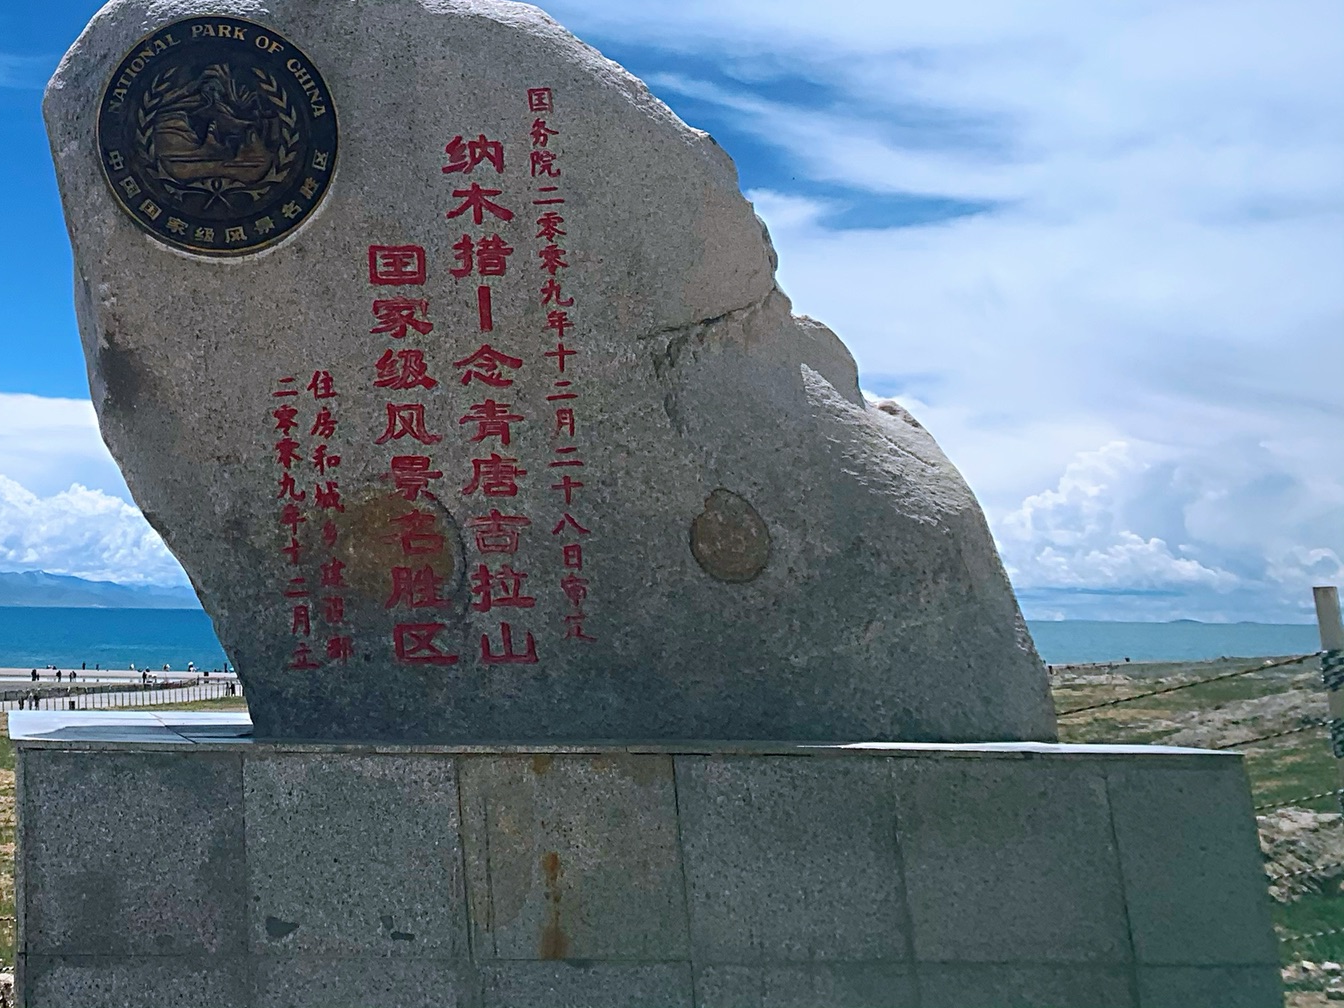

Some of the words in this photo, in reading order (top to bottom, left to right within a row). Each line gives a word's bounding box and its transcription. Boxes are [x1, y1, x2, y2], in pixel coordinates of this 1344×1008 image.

[108, 33, 181, 114] NATIONAL
[191, 24, 249, 42] PARK
[255, 35, 285, 54] OF
[286, 58, 327, 118] CHINA
[108, 149, 330, 244] 中国国家级风景名胜区
[272, 376, 322, 671] 二零零九年十二月立
[368, 244, 459, 665] 国家级风景名胜区
